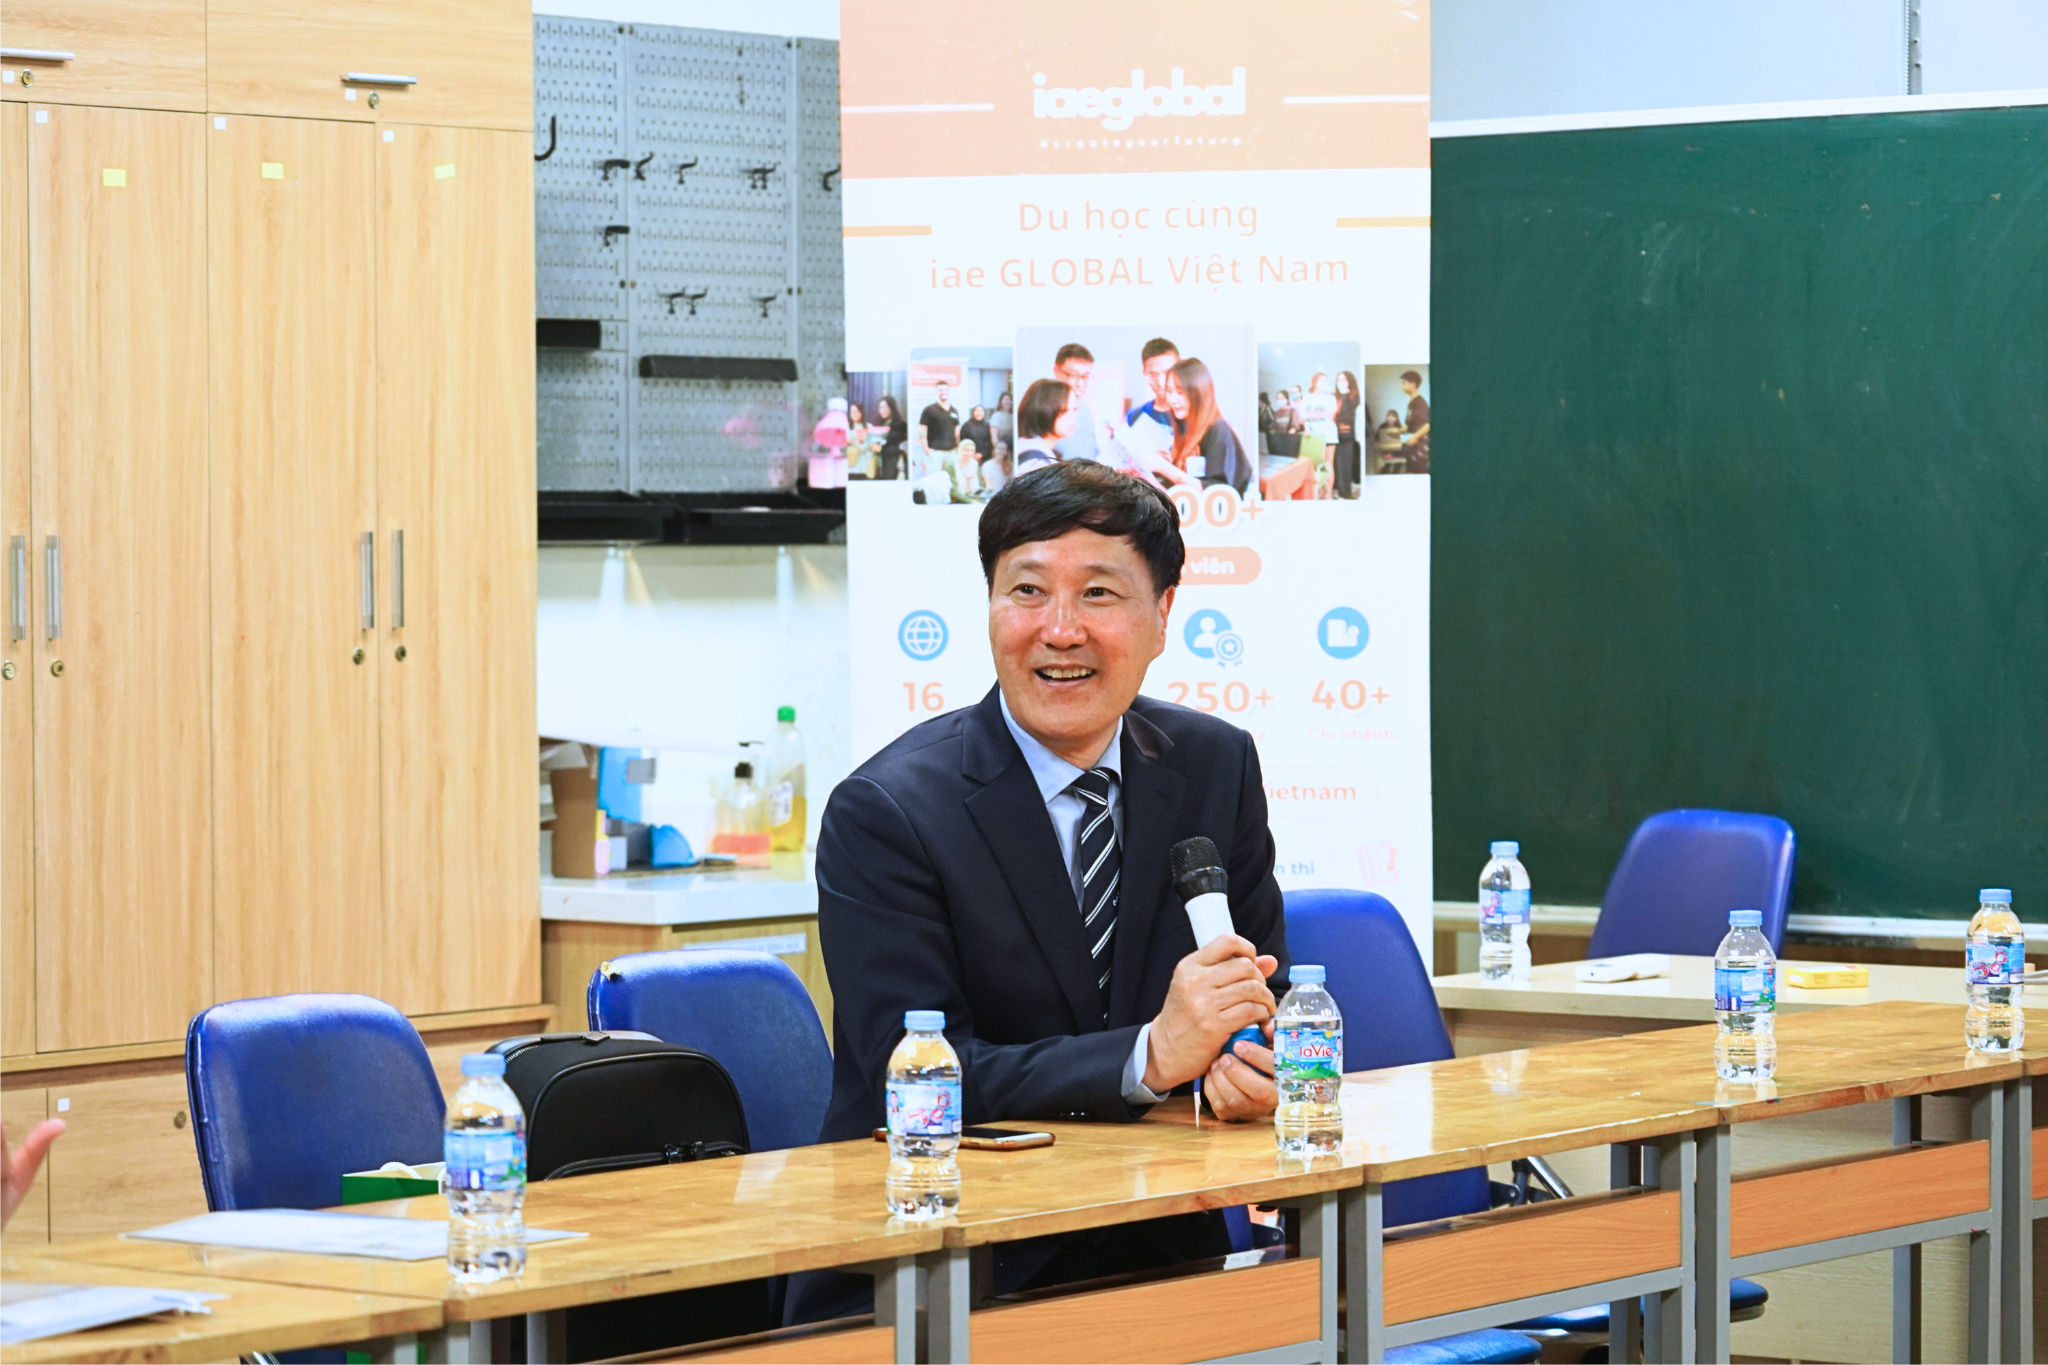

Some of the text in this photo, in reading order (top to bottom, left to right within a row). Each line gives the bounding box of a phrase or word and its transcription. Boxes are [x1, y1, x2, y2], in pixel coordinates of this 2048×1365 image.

[1033, 67, 1246, 131] iaeglobal
[1019, 198, 1257, 238] Du học cùng
[931, 254, 1348, 292] iae GLOBAL Việt Nam
[1190, 556, 1235, 575] viên
[902, 682, 945, 712] 16
[1167, 681, 1274, 713] 250+
[1312, 679, 1389, 711] 40+
[1263, 782, 1357, 800] ietnam
[1291, 861, 1314, 875] thi
[1299, 1044, 1333, 1057] laVie
